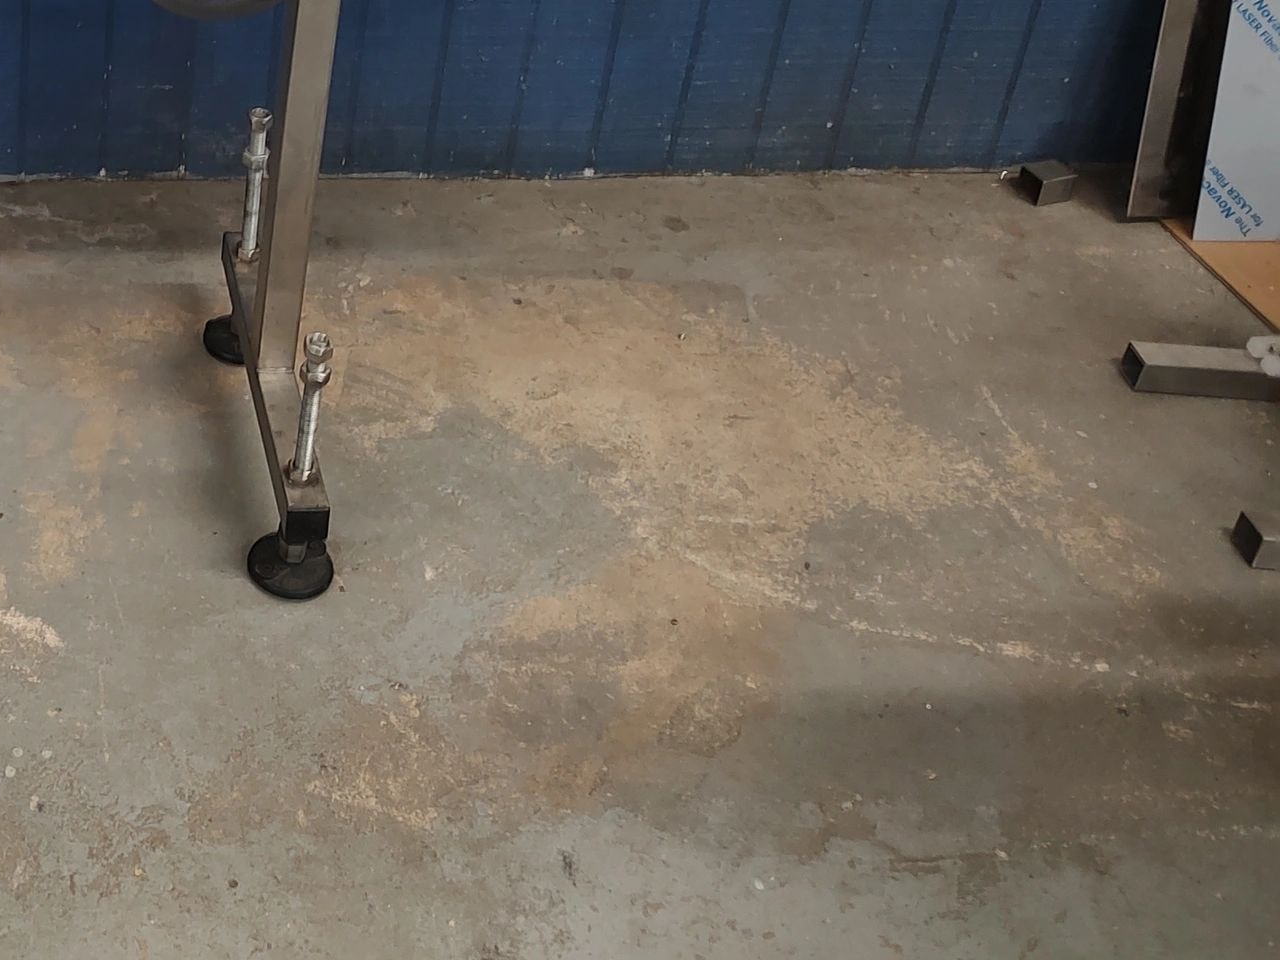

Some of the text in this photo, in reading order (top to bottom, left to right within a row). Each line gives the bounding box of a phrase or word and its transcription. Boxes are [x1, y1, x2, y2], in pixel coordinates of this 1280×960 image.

[1236, 2, 1263, 32] LASER
[1209, 166, 1264, 227] for LASER Fiber
[1235, 216, 1252, 237] The
